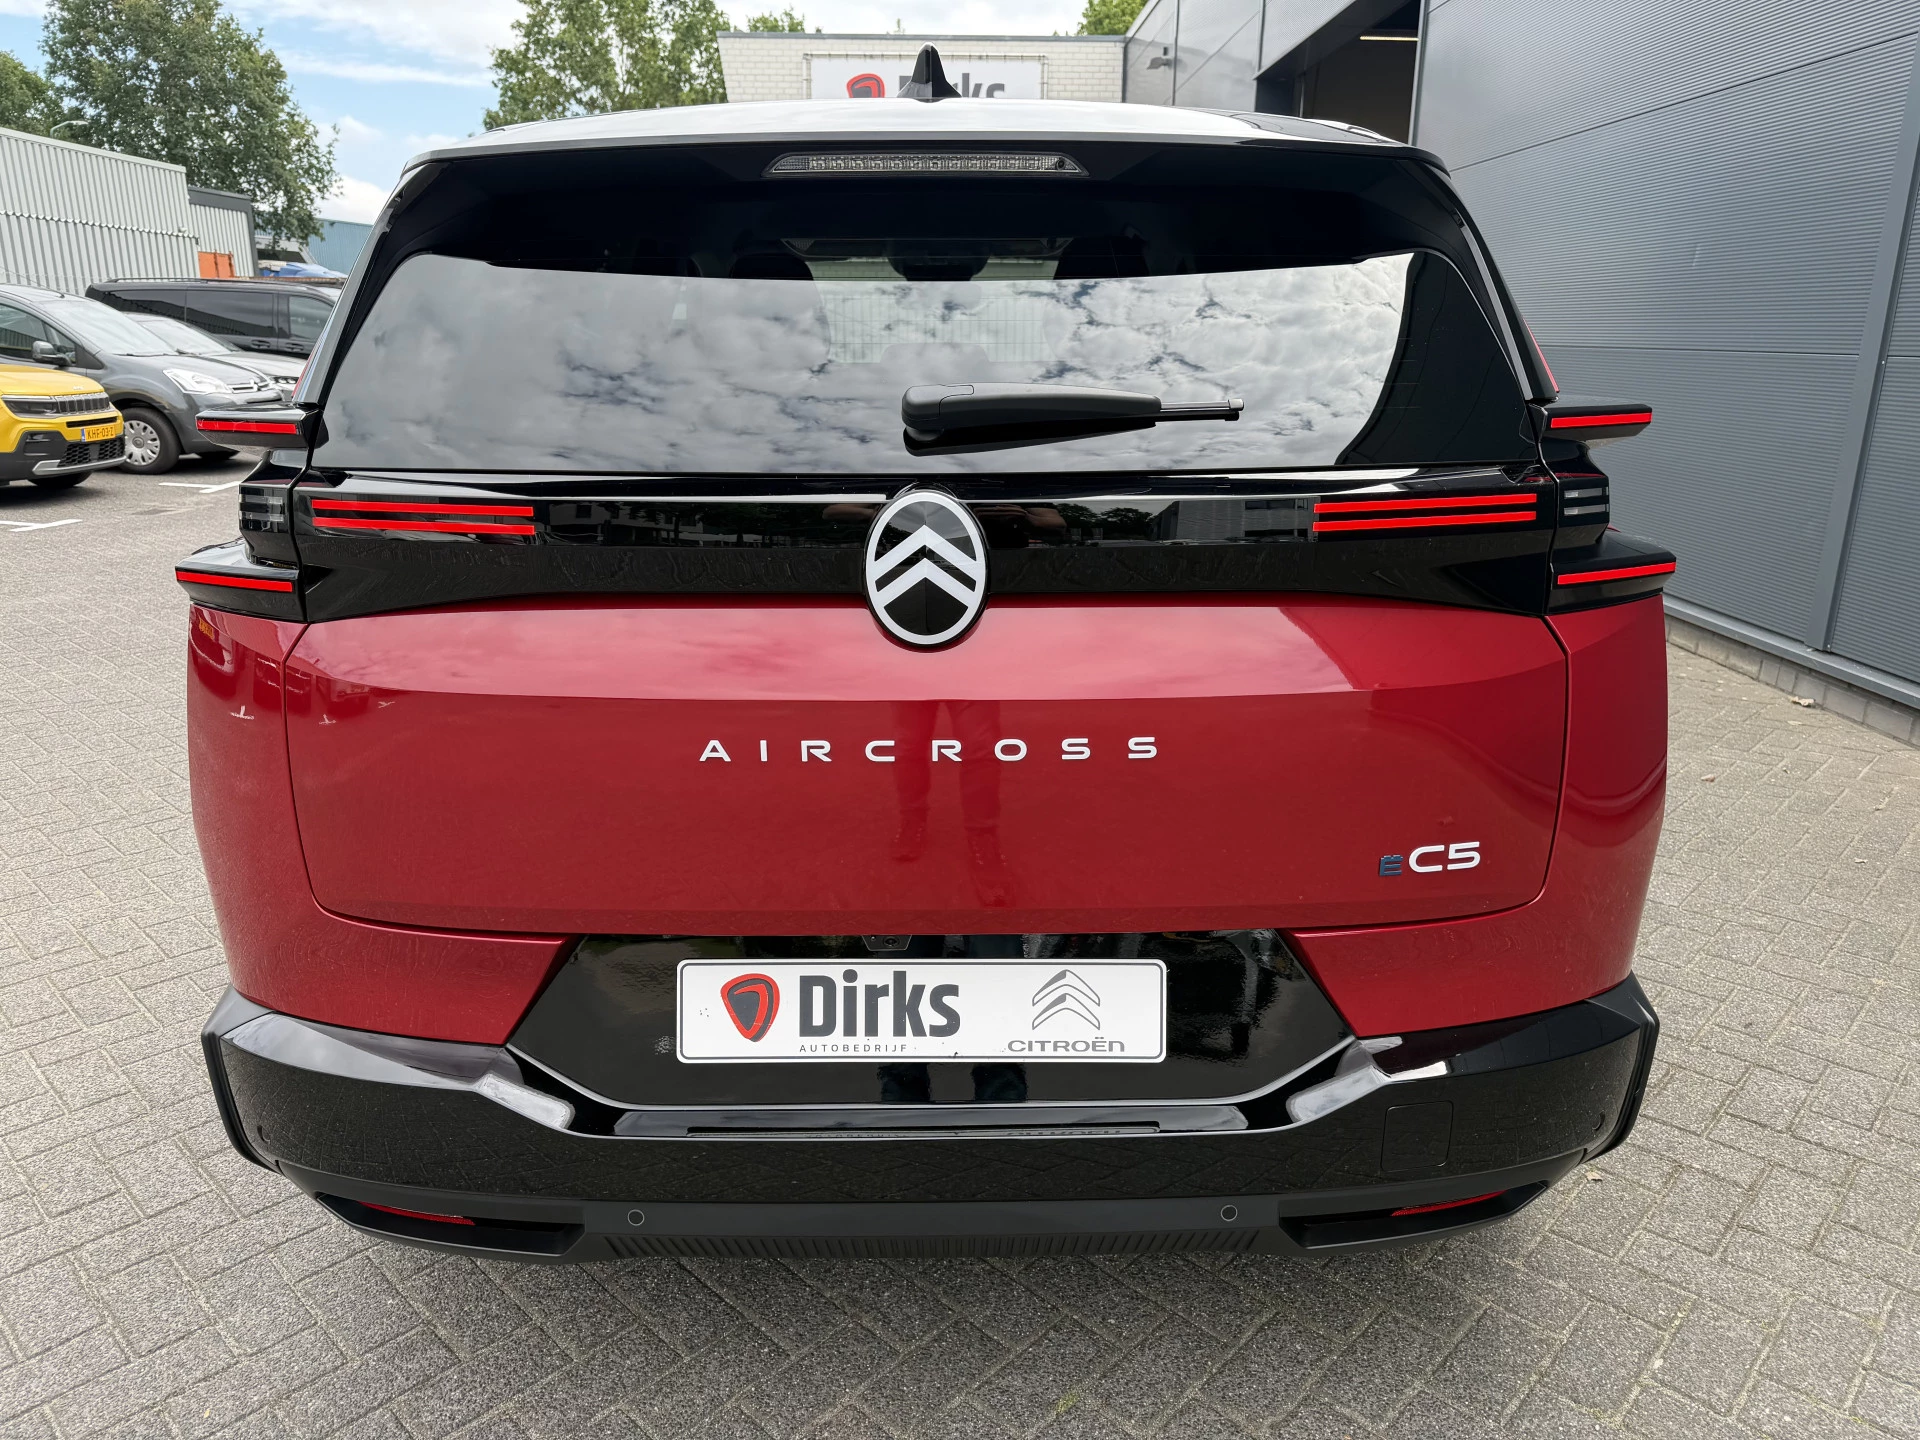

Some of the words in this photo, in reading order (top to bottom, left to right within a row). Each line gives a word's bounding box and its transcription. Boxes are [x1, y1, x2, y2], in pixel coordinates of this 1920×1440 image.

[699, 736, 1157, 763] AIRCROSS
[799, 968, 961, 1038] Dirks
[799, 1044, 907, 1053] AUTOBEDRIJF
